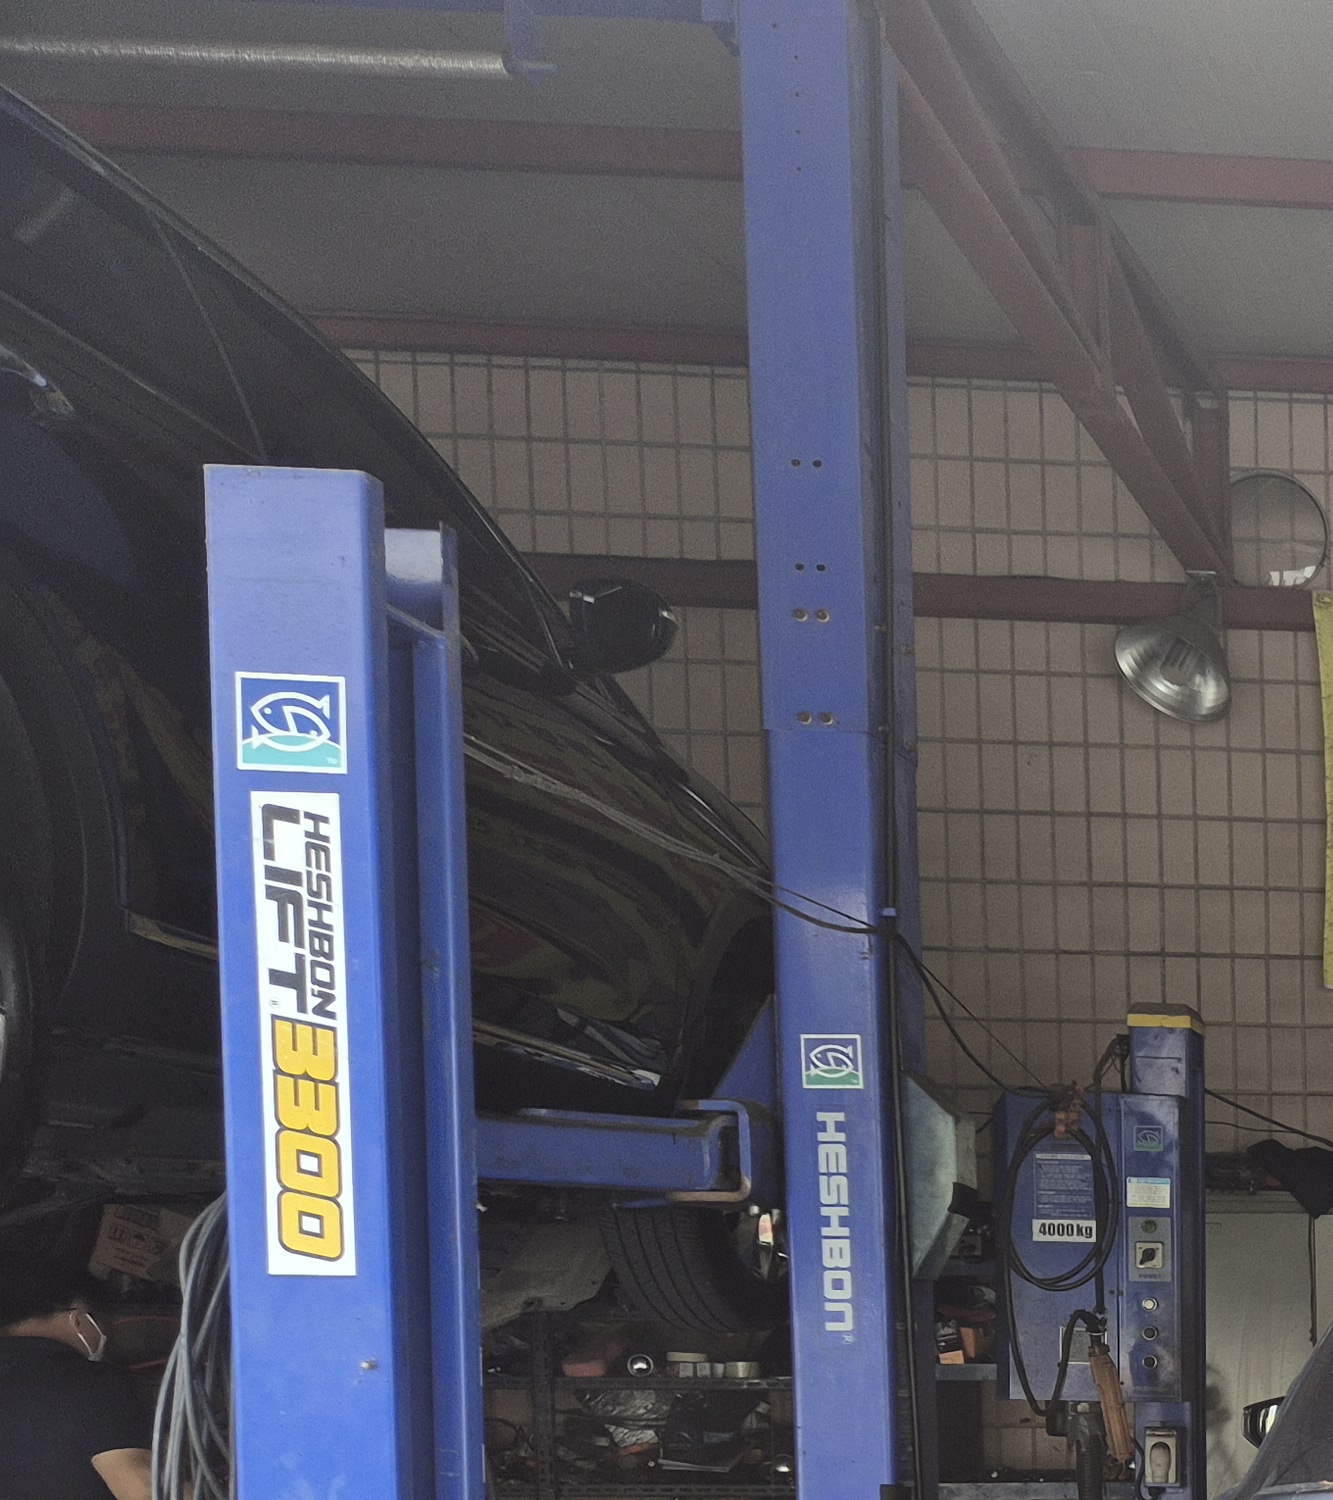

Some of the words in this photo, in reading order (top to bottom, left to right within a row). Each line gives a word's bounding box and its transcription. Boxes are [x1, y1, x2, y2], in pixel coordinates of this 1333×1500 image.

[261, 803, 308, 1014] LIFT
[303, 810, 337, 1020] HESHBON
[271, 1016, 344, 1262] 3300
[816, 1111, 854, 1332] HESHBON
